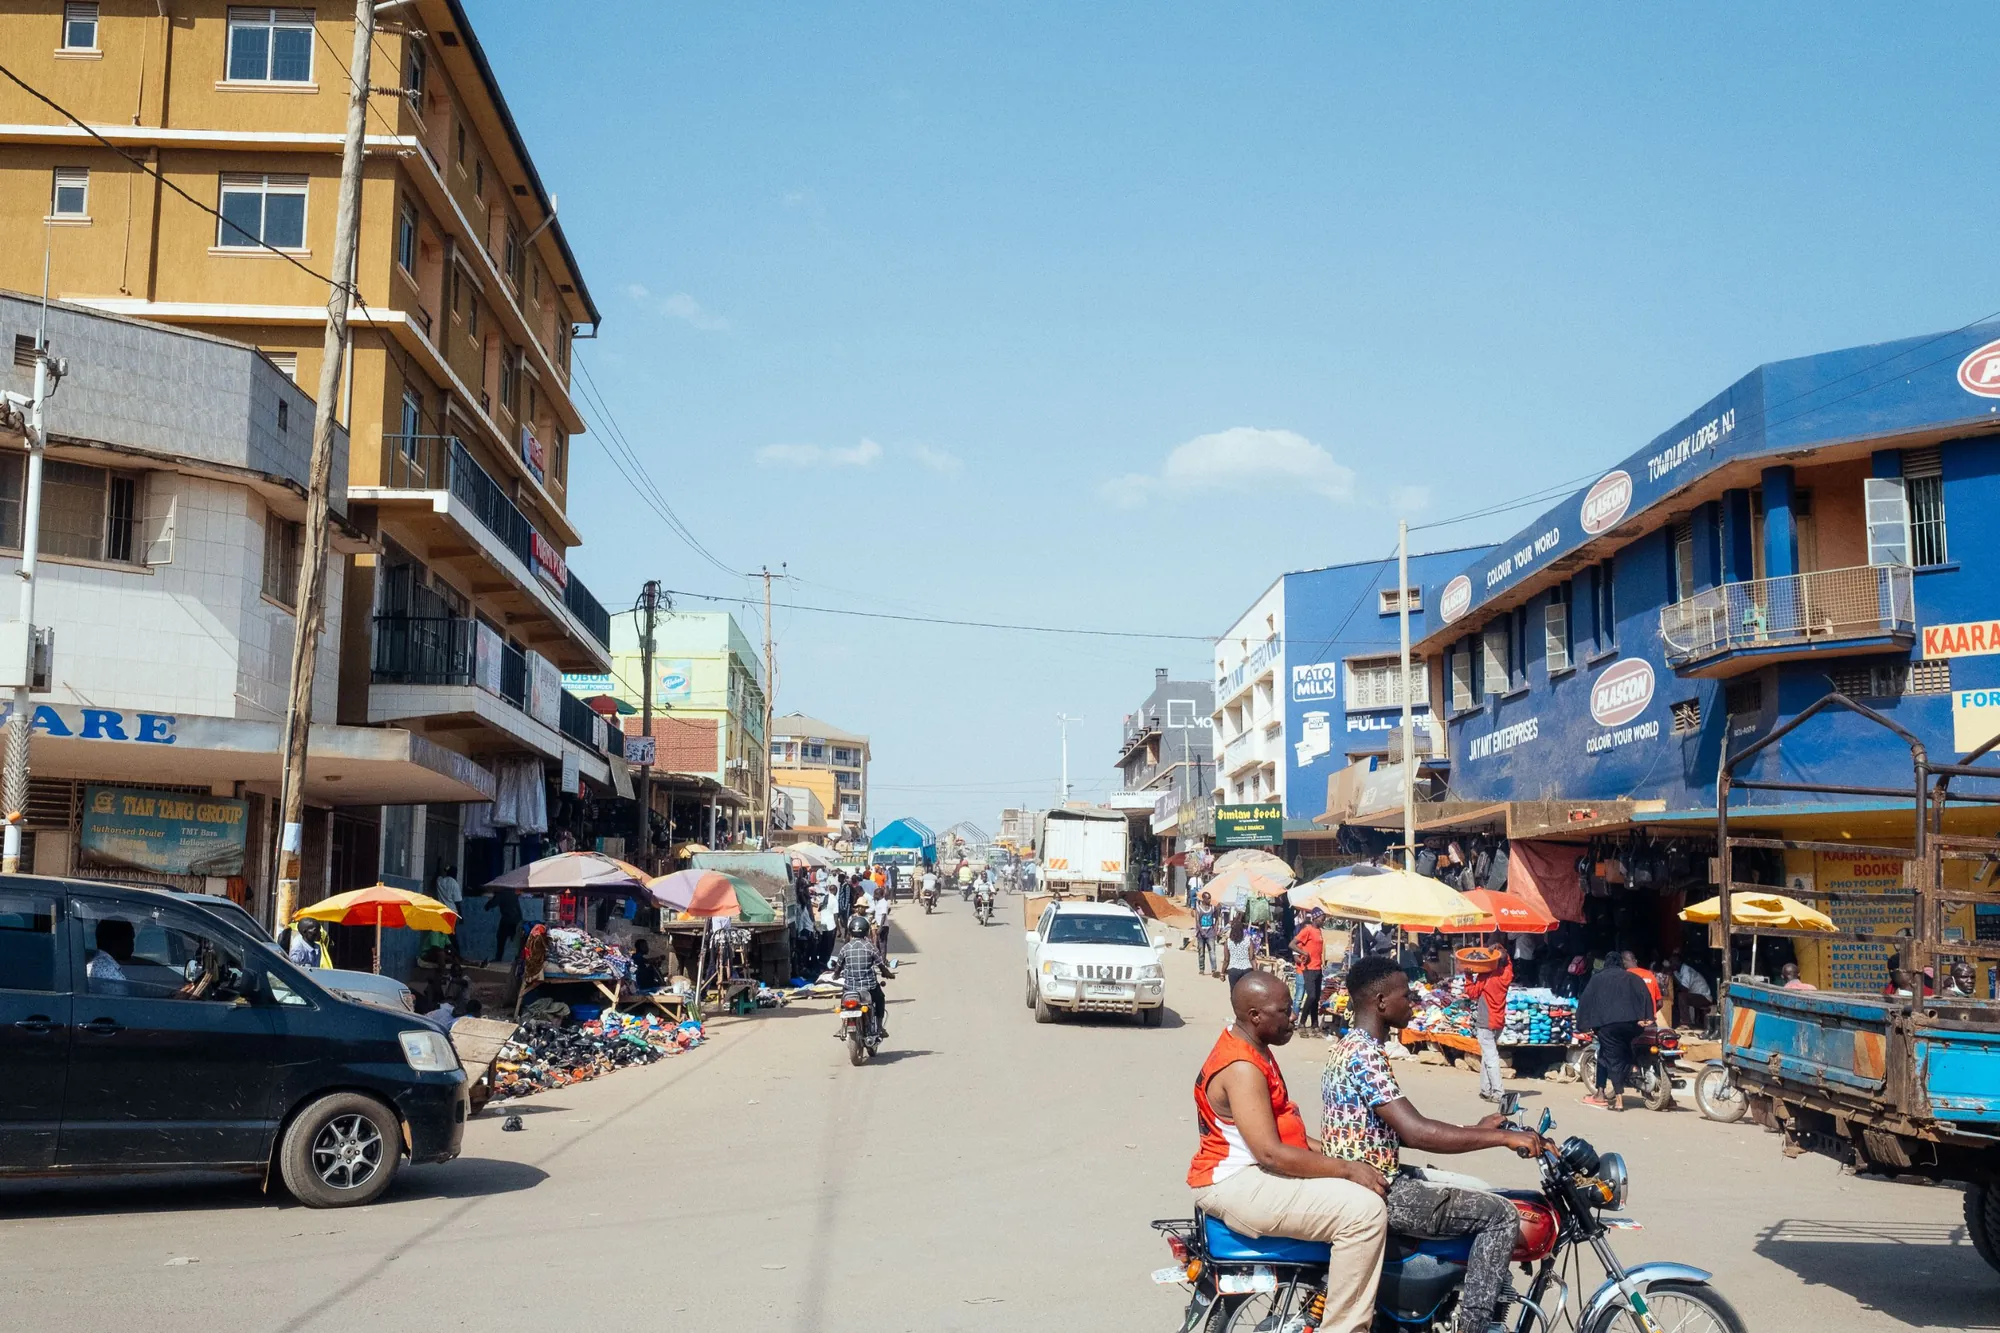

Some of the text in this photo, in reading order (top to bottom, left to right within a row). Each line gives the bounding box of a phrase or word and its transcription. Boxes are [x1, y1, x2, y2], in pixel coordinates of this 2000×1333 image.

[1692, 419, 1719, 455] LODGE
[1586, 481, 1627, 523] PLASCON
[1487, 527, 1560, 587] COLOUR YOUR WORLD
[1925, 623, 2000, 655] KAARA
[1297, 667, 1332, 680] LATO
[1596, 674, 1648, 713] PLASCON
[0, 702, 177, 744] ARE
[1347, 717, 1392, 732] FULL
[1469, 717, 1539, 761] JAYANT ENTERPRISES
[1586, 720, 1659, 754] COLOUR YOUR WORLD
[122, 795, 244, 825] TIAN TANG GROUP
[1253, 807, 1280, 819] Seeds
[90, 824, 136, 836] Authorised
[181, 827, 198, 835] TMT
[1830, 880, 1897, 888] PHOTOCOPY
[1831, 907, 1885, 916] STAPLING
[1831, 915, 1914, 924] MATHEMATICA
[1832, 944, 1886, 952] MARKERS
[1833, 953, 1889, 961] BOX FILES
[1832, 963, 1886, 971] EXERCISE
